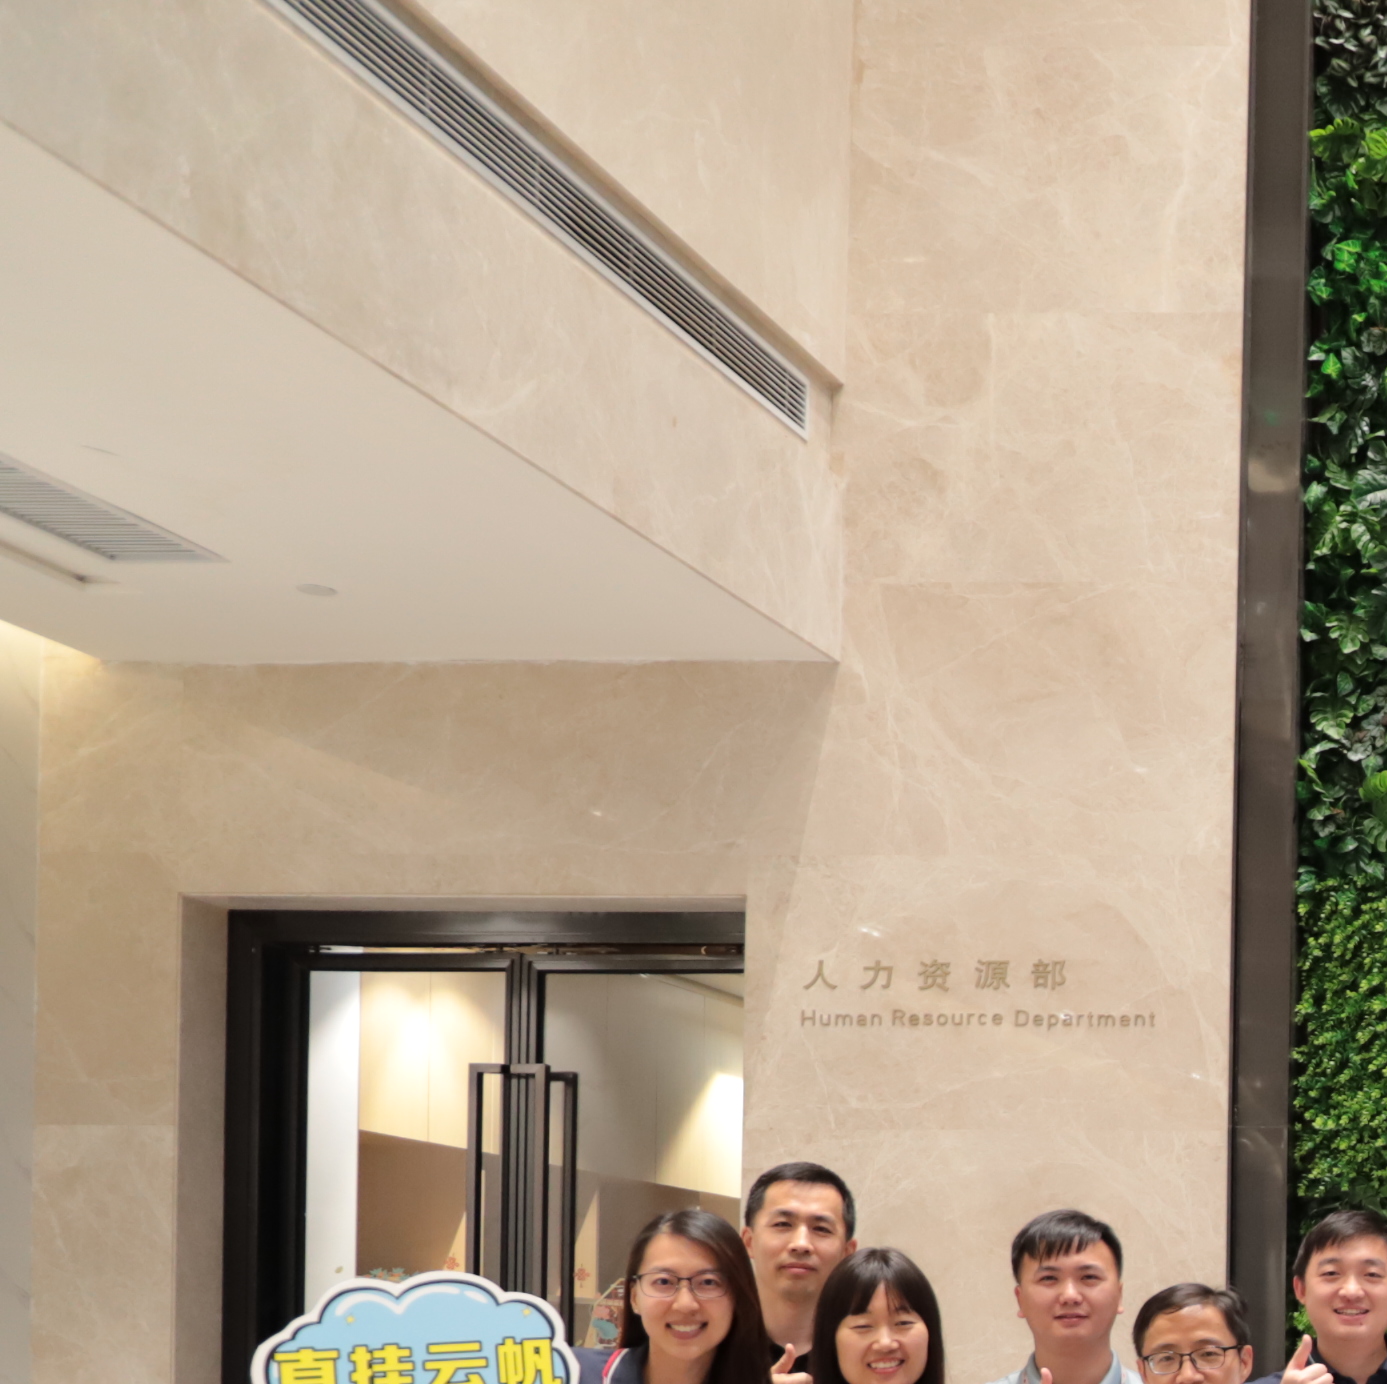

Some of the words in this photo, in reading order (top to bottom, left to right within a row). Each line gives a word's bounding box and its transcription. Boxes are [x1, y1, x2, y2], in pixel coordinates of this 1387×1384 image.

[803, 958, 1067, 992] 人力资源部
[801, 1009, 883, 1027] Human
[891, 1009, 1004, 1027] Resource
[1013, 1009, 1156, 1031] Department
